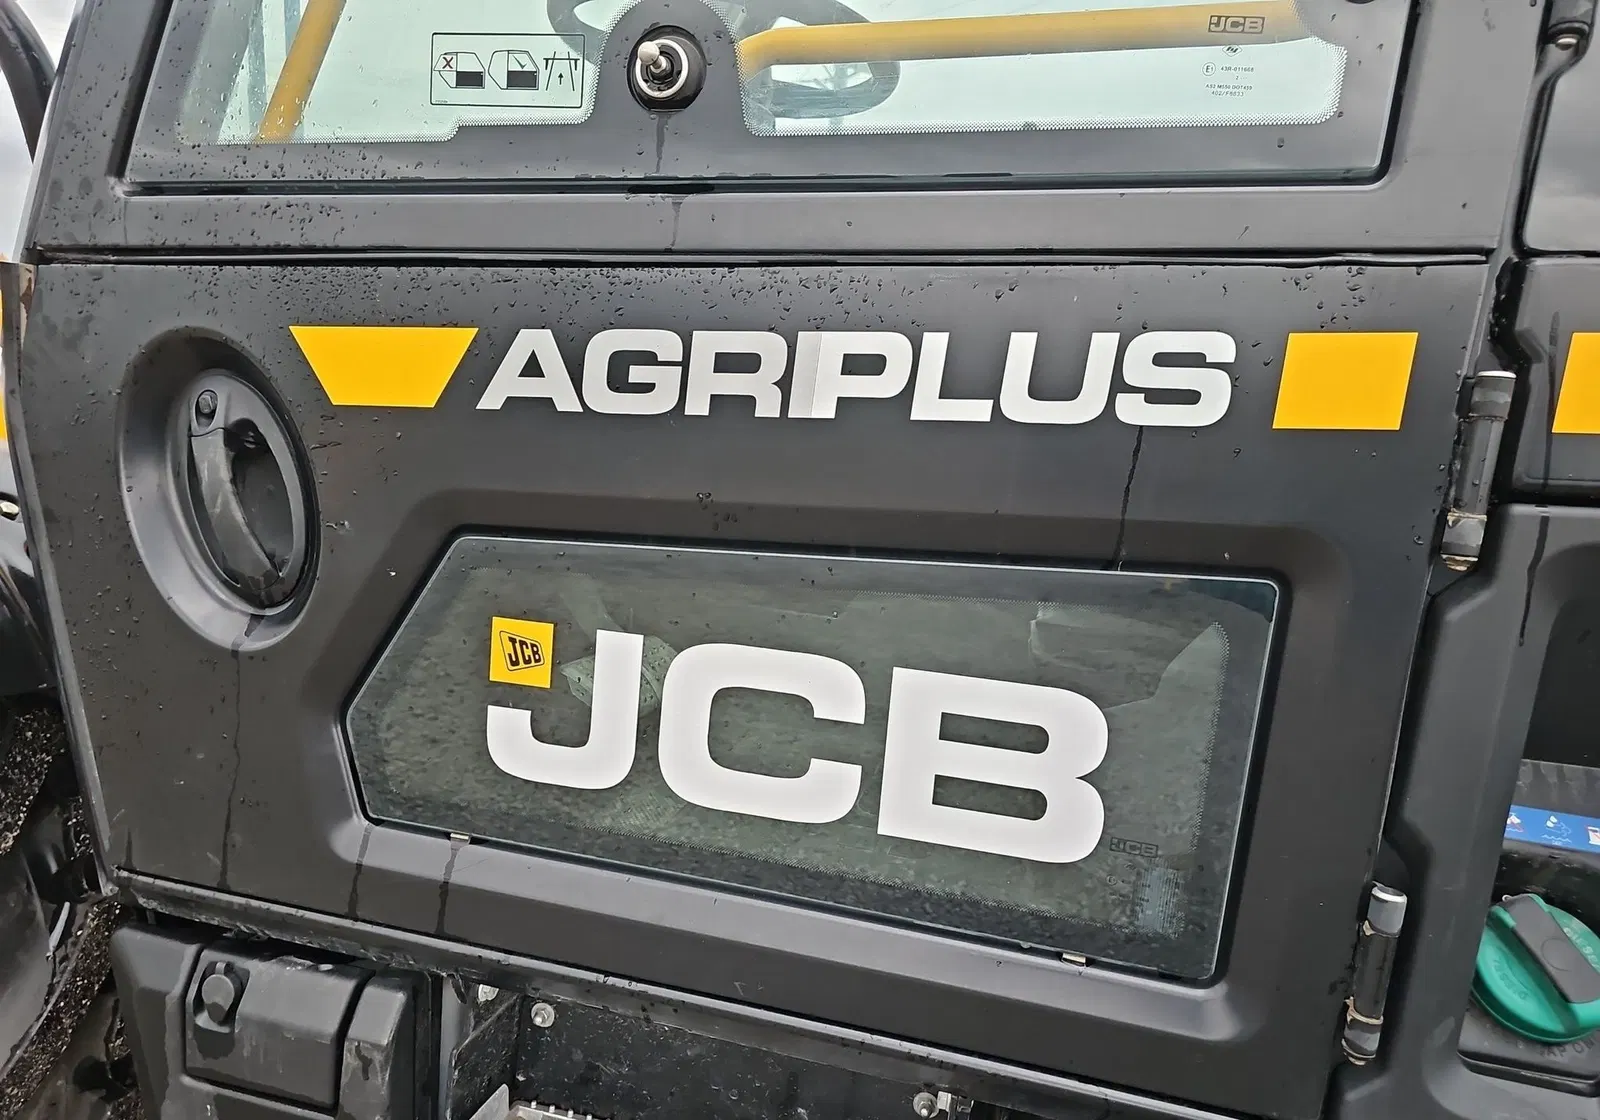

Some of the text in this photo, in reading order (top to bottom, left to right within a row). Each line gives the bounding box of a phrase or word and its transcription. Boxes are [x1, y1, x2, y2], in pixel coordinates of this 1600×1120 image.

[1208, 15, 1265, 34] JCB
[475, 329, 1237, 427] AGRIPLUS
[507, 636, 542, 667] JCB
[486, 629, 1109, 864] JCB
[1109, 837, 1159, 858] JCB
